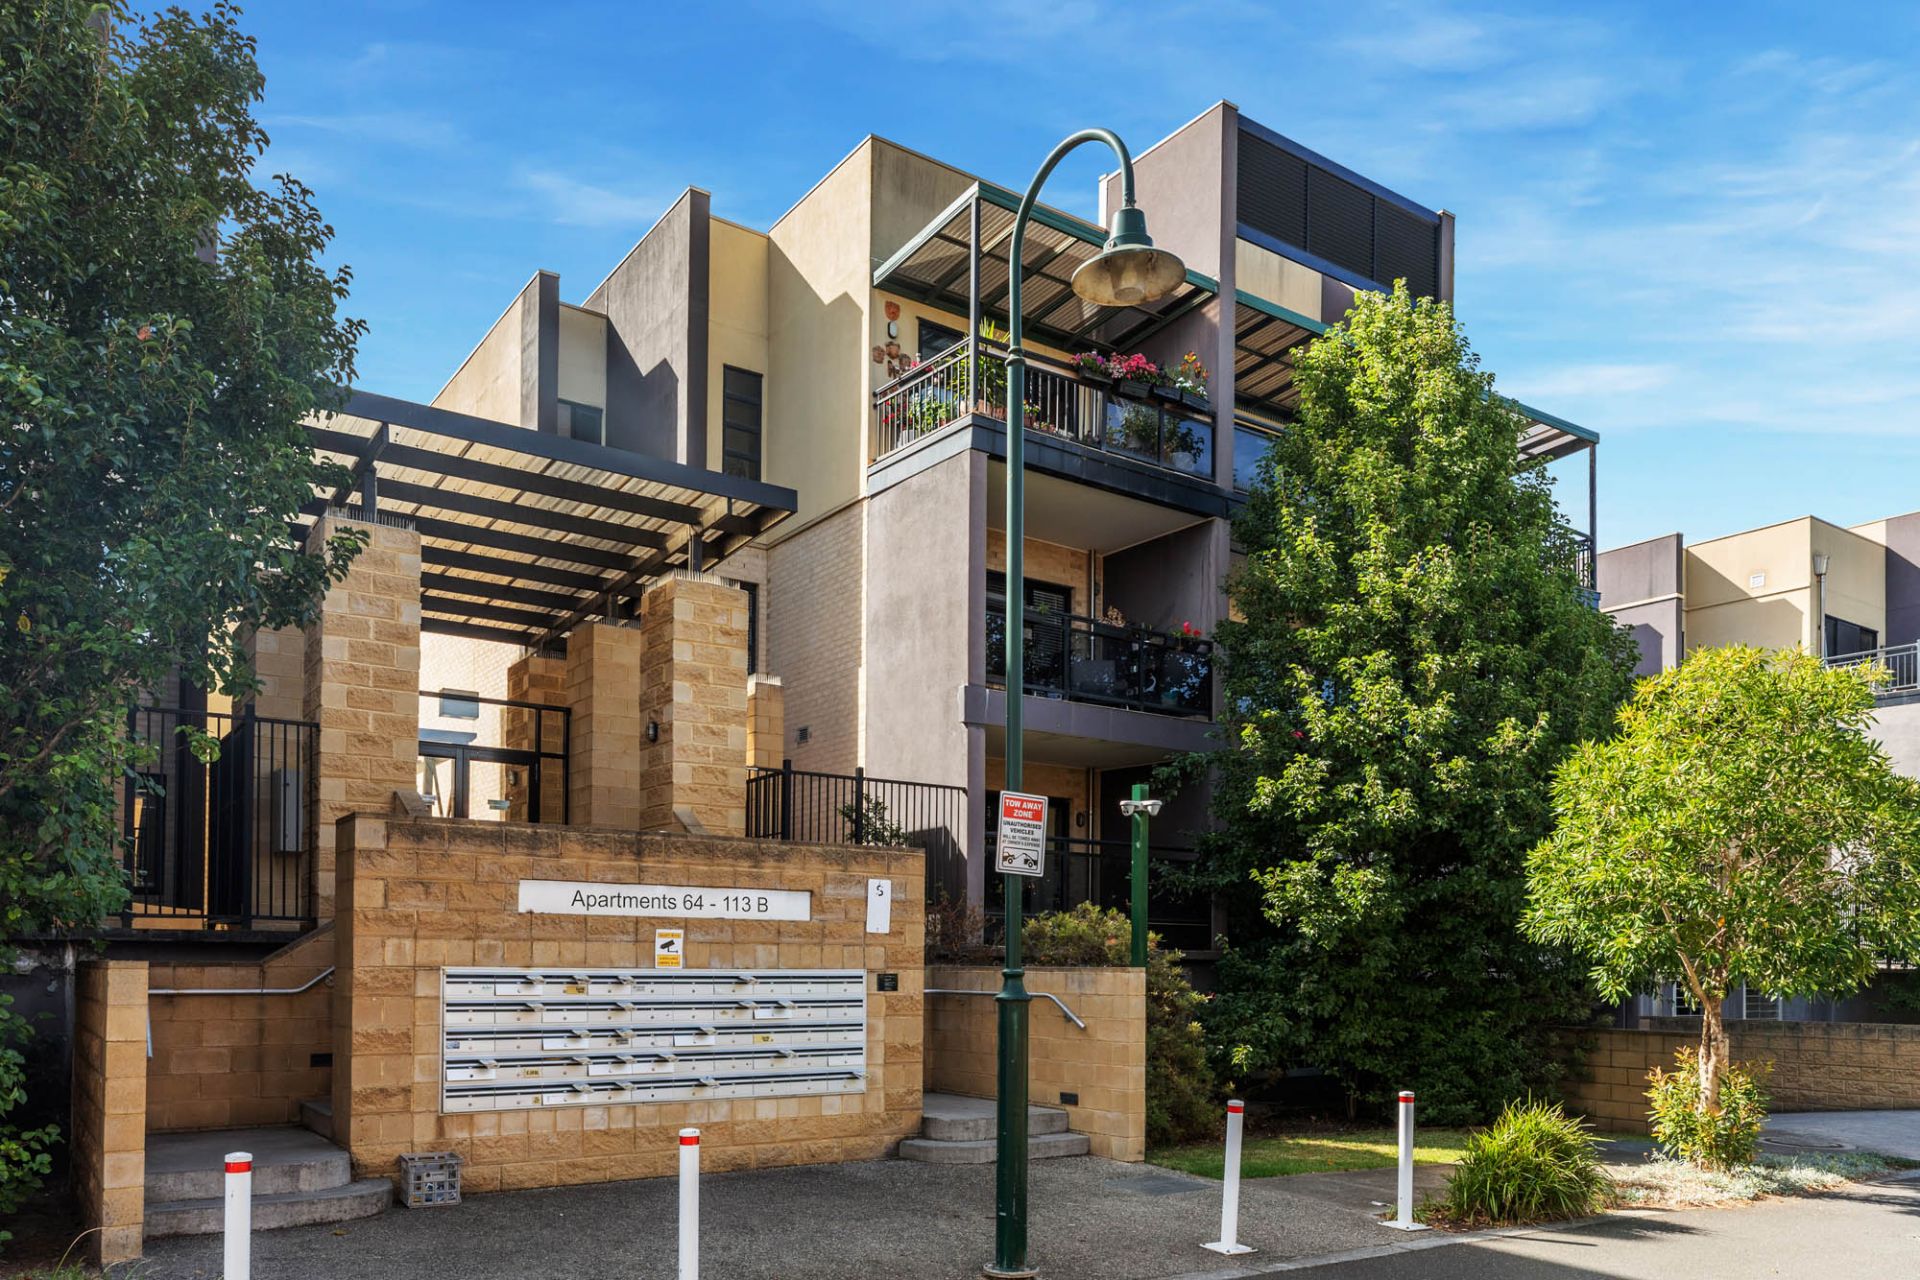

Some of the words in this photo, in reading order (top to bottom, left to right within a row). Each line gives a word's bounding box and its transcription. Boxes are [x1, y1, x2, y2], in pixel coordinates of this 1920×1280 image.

[1005, 799, 1021, 807] TOW
[1022, 801, 1042, 810] AWAY
[1013, 809, 1033, 818] ZONE
[572, 890, 676, 910] Apartments
[684, 894, 703, 910] 64
[724, 896, 750, 912] 113
[758, 897, 768, 912] B
